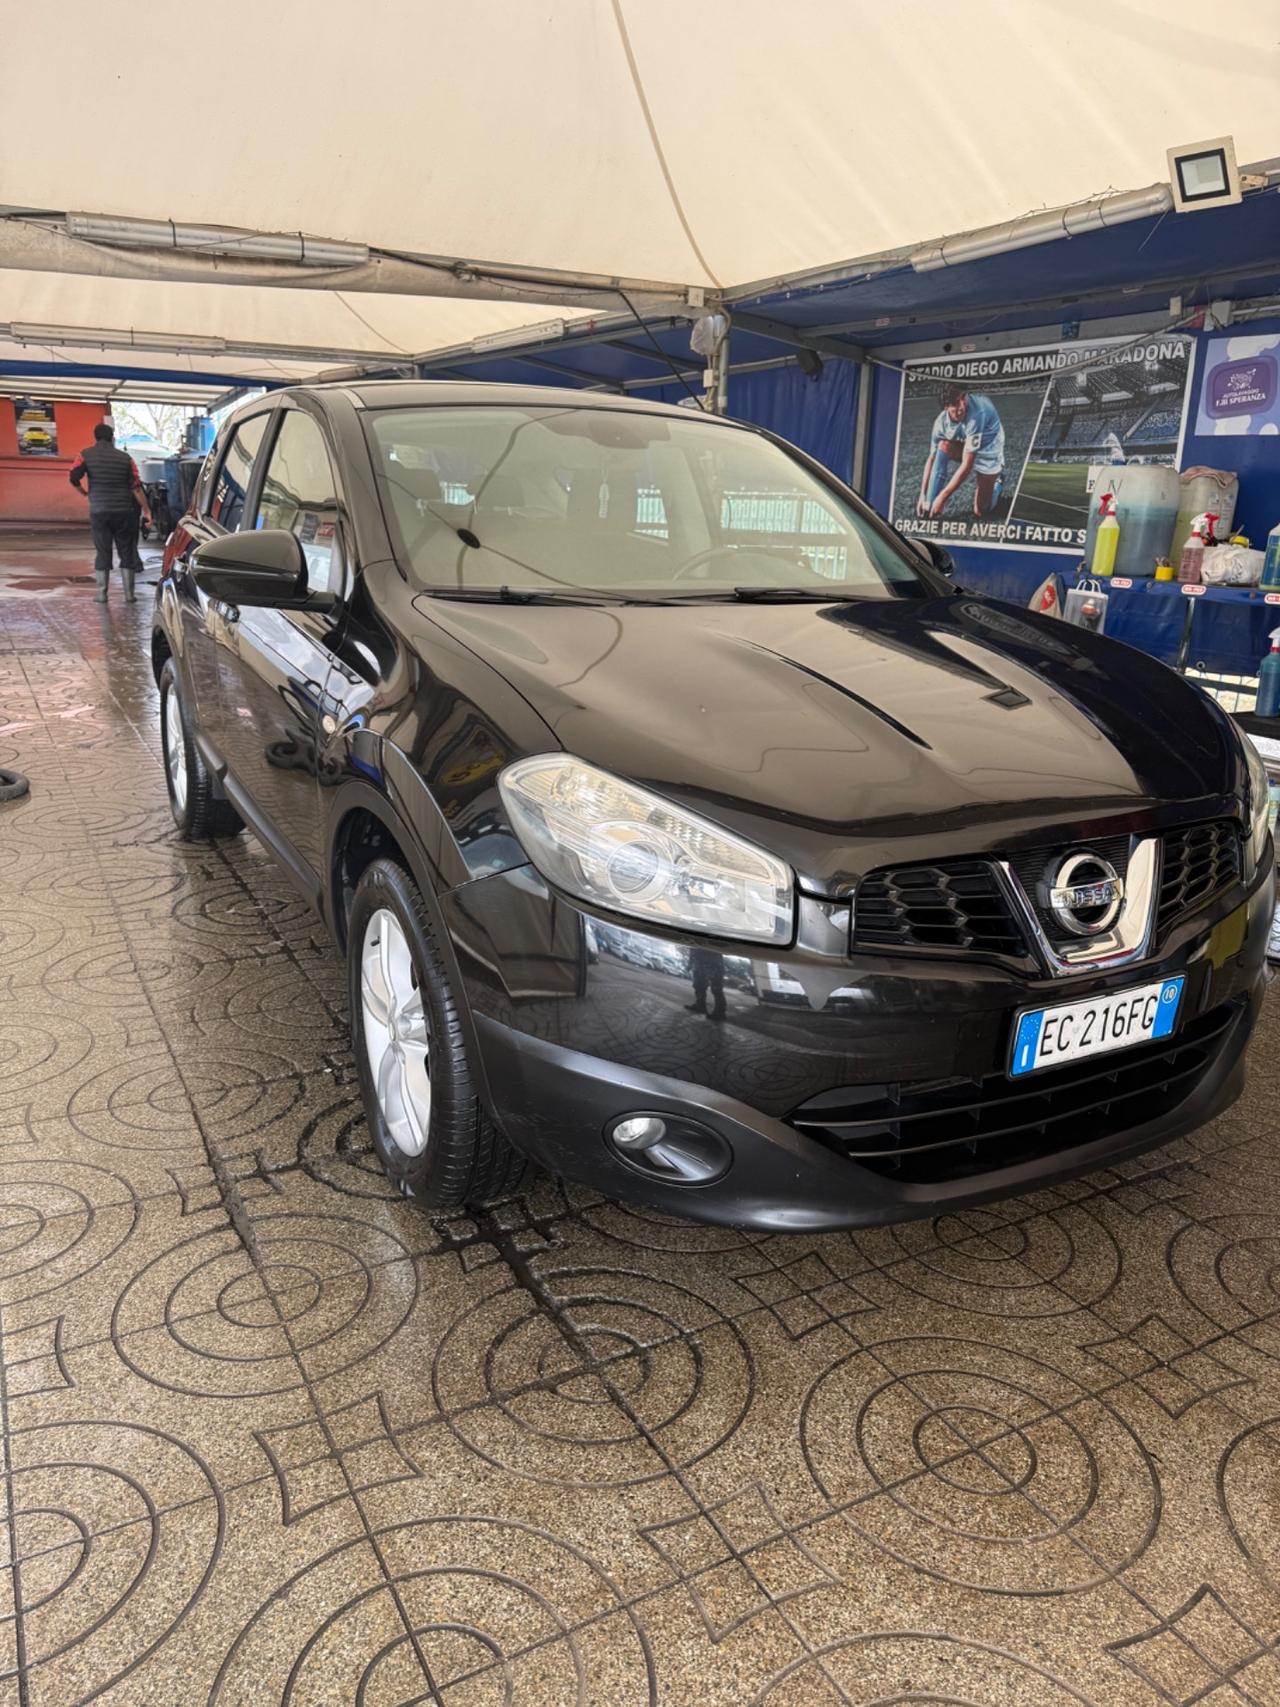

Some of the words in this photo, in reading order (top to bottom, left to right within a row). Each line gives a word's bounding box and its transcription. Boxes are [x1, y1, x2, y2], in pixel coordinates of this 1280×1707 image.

[908, 363, 954, 381] STADIO
[956, 360, 999, 378] DIEGO
[1002, 352, 1079, 374] ARMANDO
[1084, 341, 1186, 365] MARADONA
[1229, 393, 1266, 404] SPERANZA
[894, 519, 939, 534] GRAZIE
[941, 521, 967, 536] PER
[969, 523, 1021, 540] AVERCI
[1024, 526, 1073, 543] FATTO
